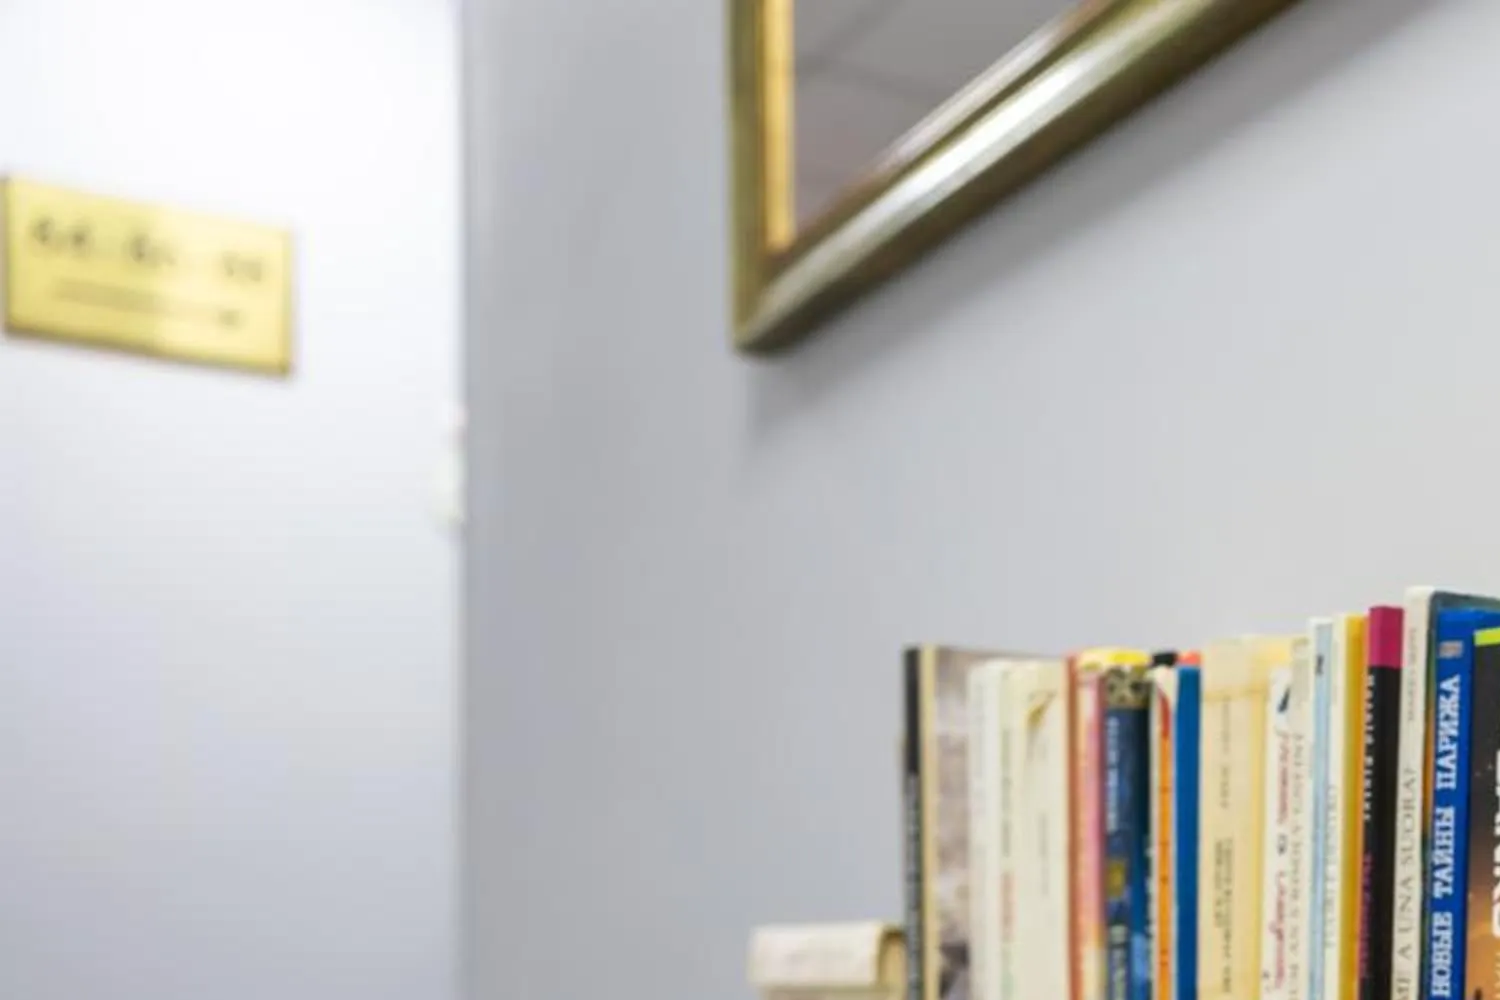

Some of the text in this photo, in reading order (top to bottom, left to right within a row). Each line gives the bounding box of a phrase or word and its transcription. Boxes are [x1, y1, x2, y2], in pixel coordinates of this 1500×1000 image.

[1436, 675, 1460, 790] ПАРИЖА
[1432, 805, 1456, 899] ТАЙНЫ
[1397, 874, 1413, 933] UNA
[1395, 944, 1411, 960] A
[1431, 911, 1453, 998] НОВЫЕ
